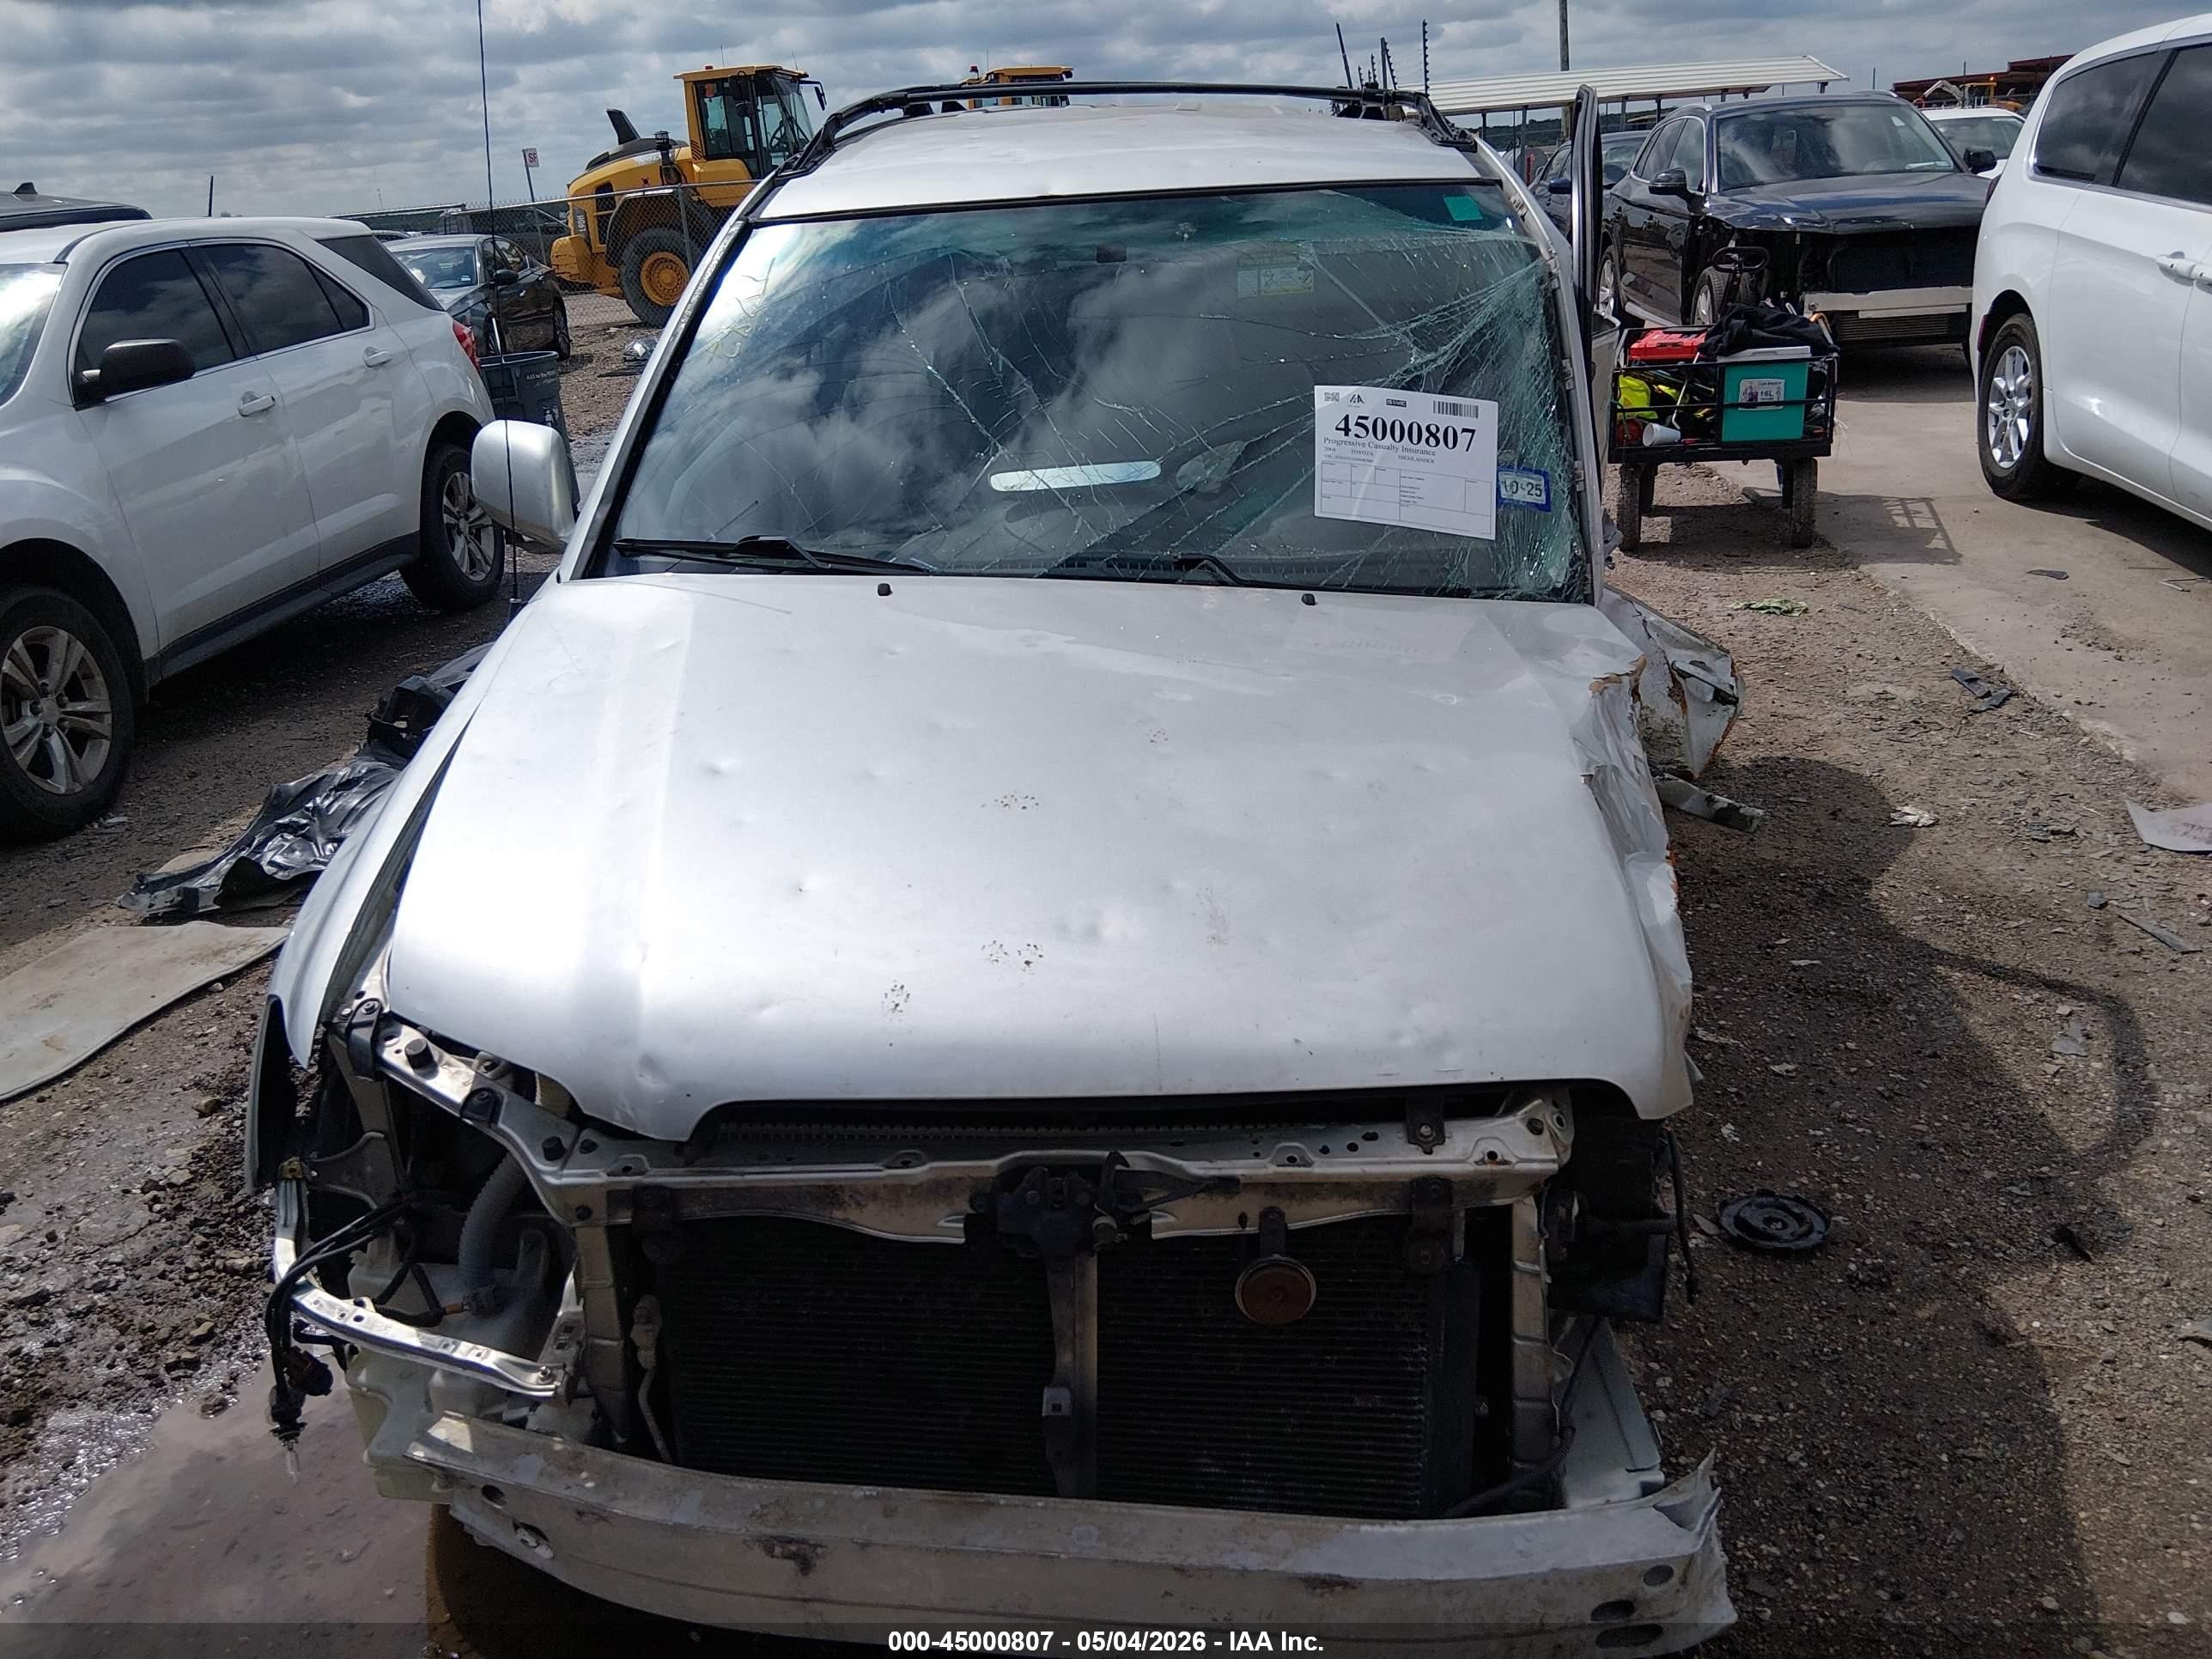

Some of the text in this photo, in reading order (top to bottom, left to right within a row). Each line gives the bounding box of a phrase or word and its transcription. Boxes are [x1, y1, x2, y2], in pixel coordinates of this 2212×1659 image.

[1334, 414, 1477, 453] 45000807
[1323, 437, 1437, 456] Progressive Casualty Insurance
[1398, 454, 1435, 463] HIGHLANDER
